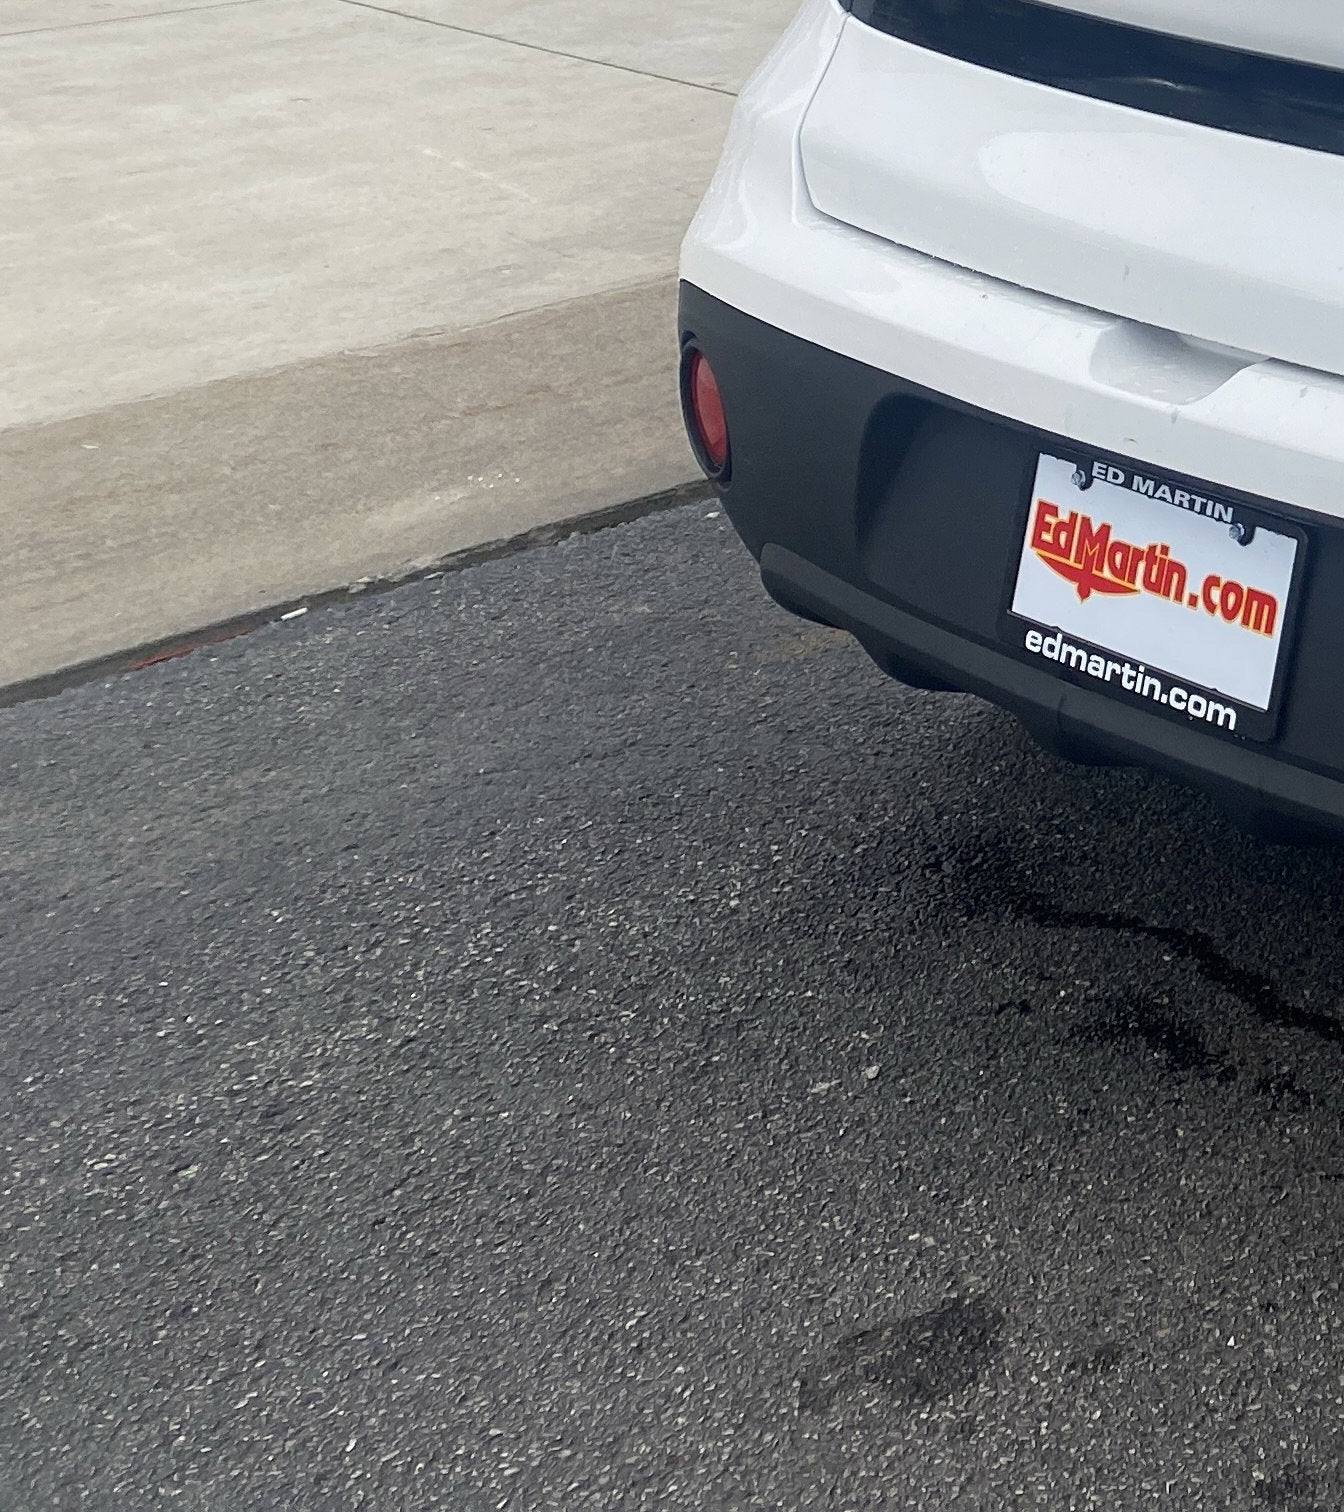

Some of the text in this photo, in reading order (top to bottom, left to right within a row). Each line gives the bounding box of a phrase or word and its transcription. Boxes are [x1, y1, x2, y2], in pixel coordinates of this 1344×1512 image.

[1091, 461, 1235, 524] ED MARTIN
[1030, 498, 1279, 638] EdMartin.com
[1024, 628, 1238, 731] edmartin.com
